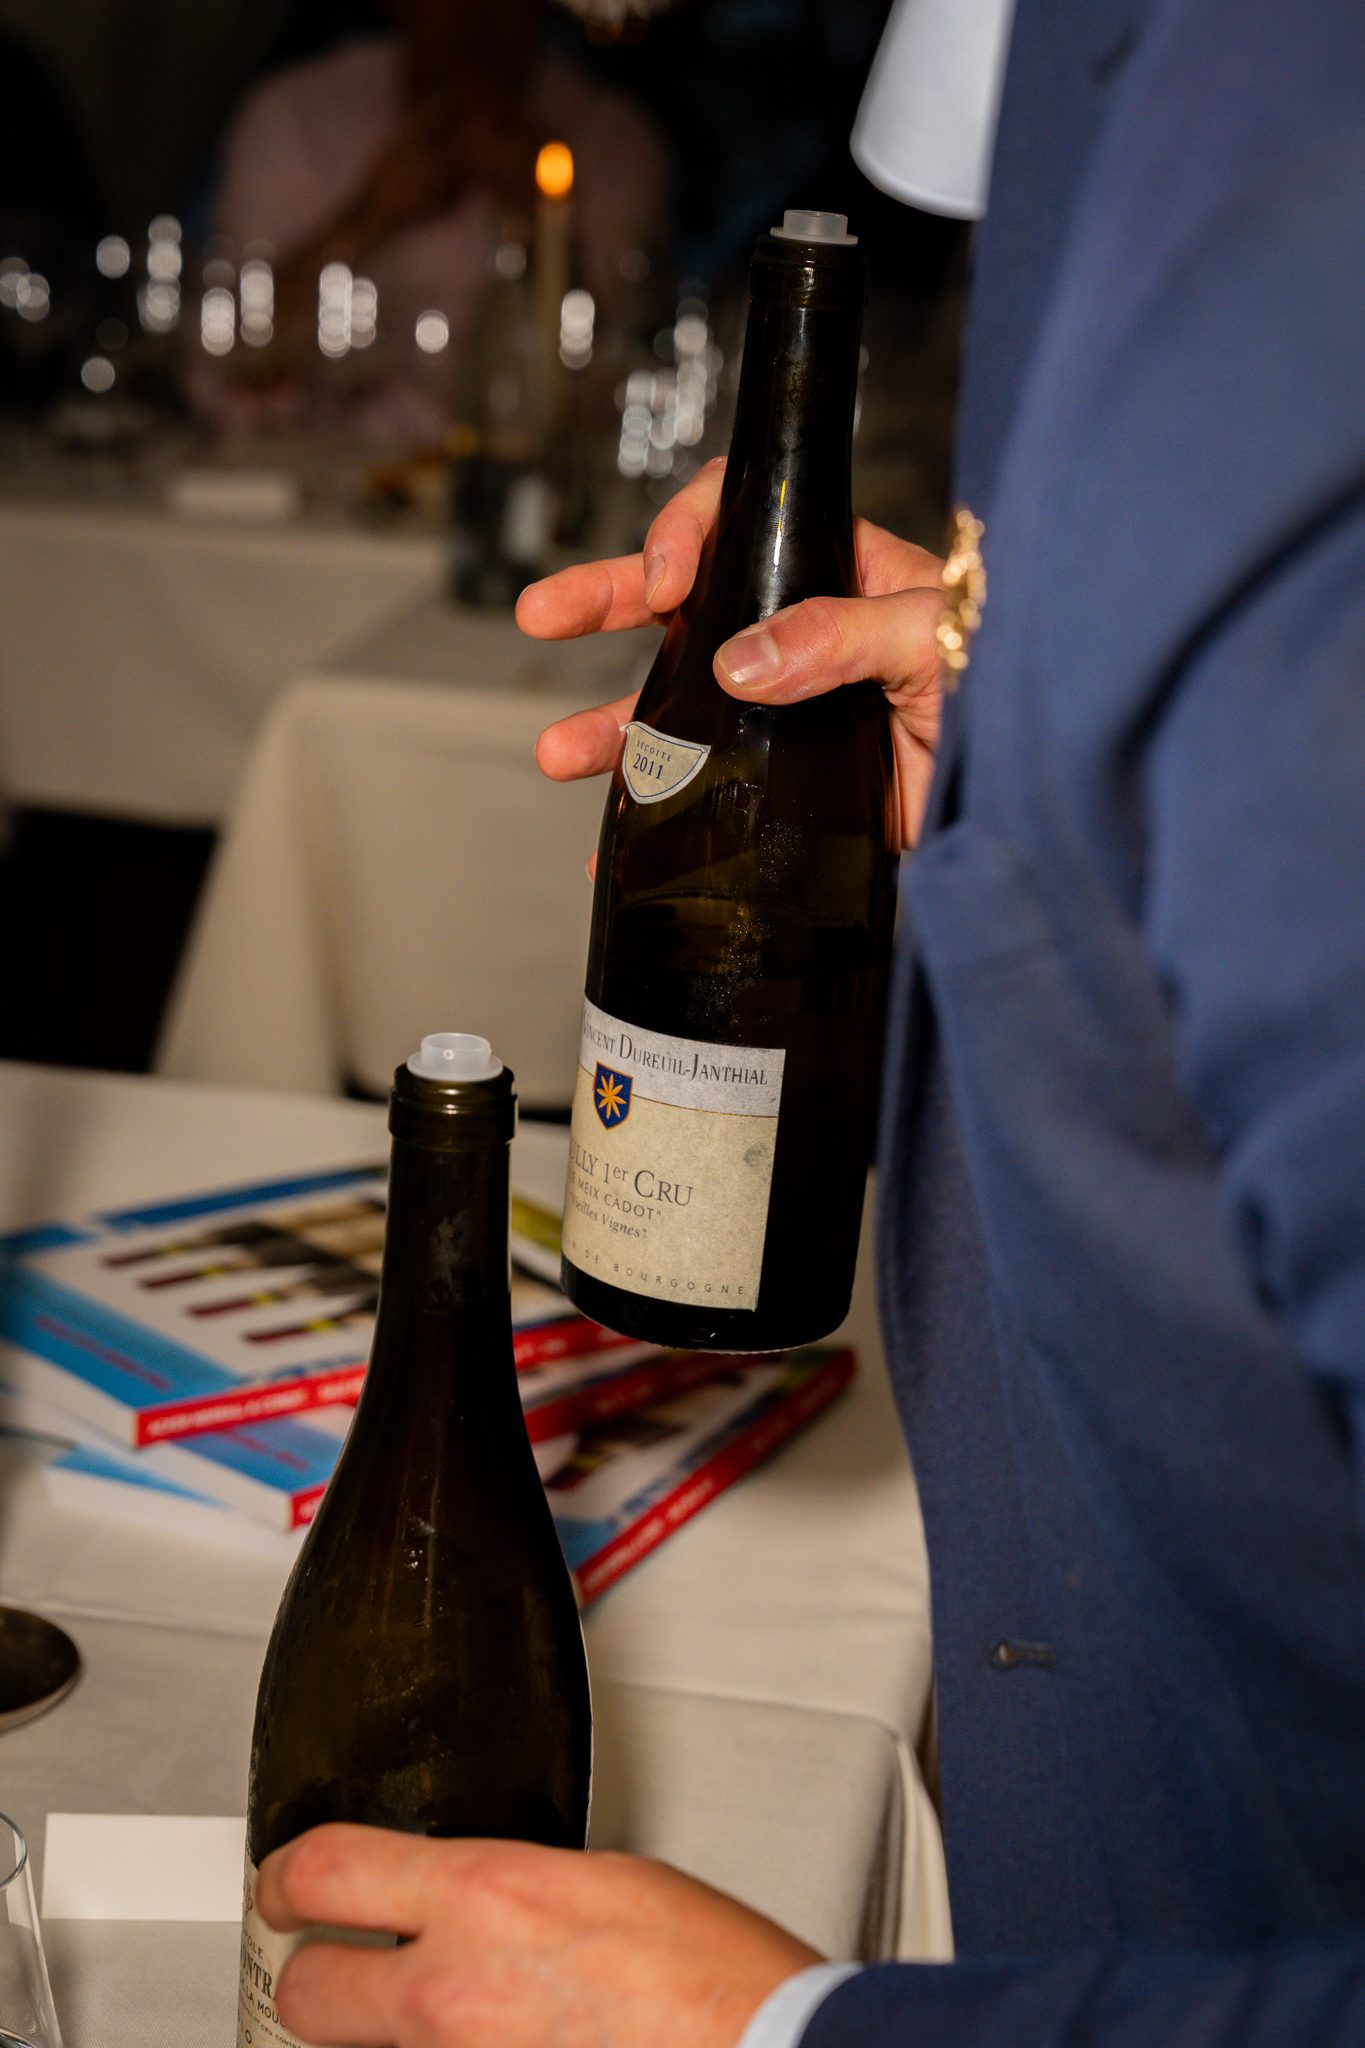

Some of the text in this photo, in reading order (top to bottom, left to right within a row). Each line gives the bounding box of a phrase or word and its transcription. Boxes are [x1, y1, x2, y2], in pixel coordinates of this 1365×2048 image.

[632, 752, 664, 780] 2011
[619, 1033, 768, 1085] DUREUIL-JANTHIAL
[603, 1161, 629, 1184] 1er
[634, 1169, 694, 1206] CRU
[613, 1263, 745, 1296] BOURGOGNE
